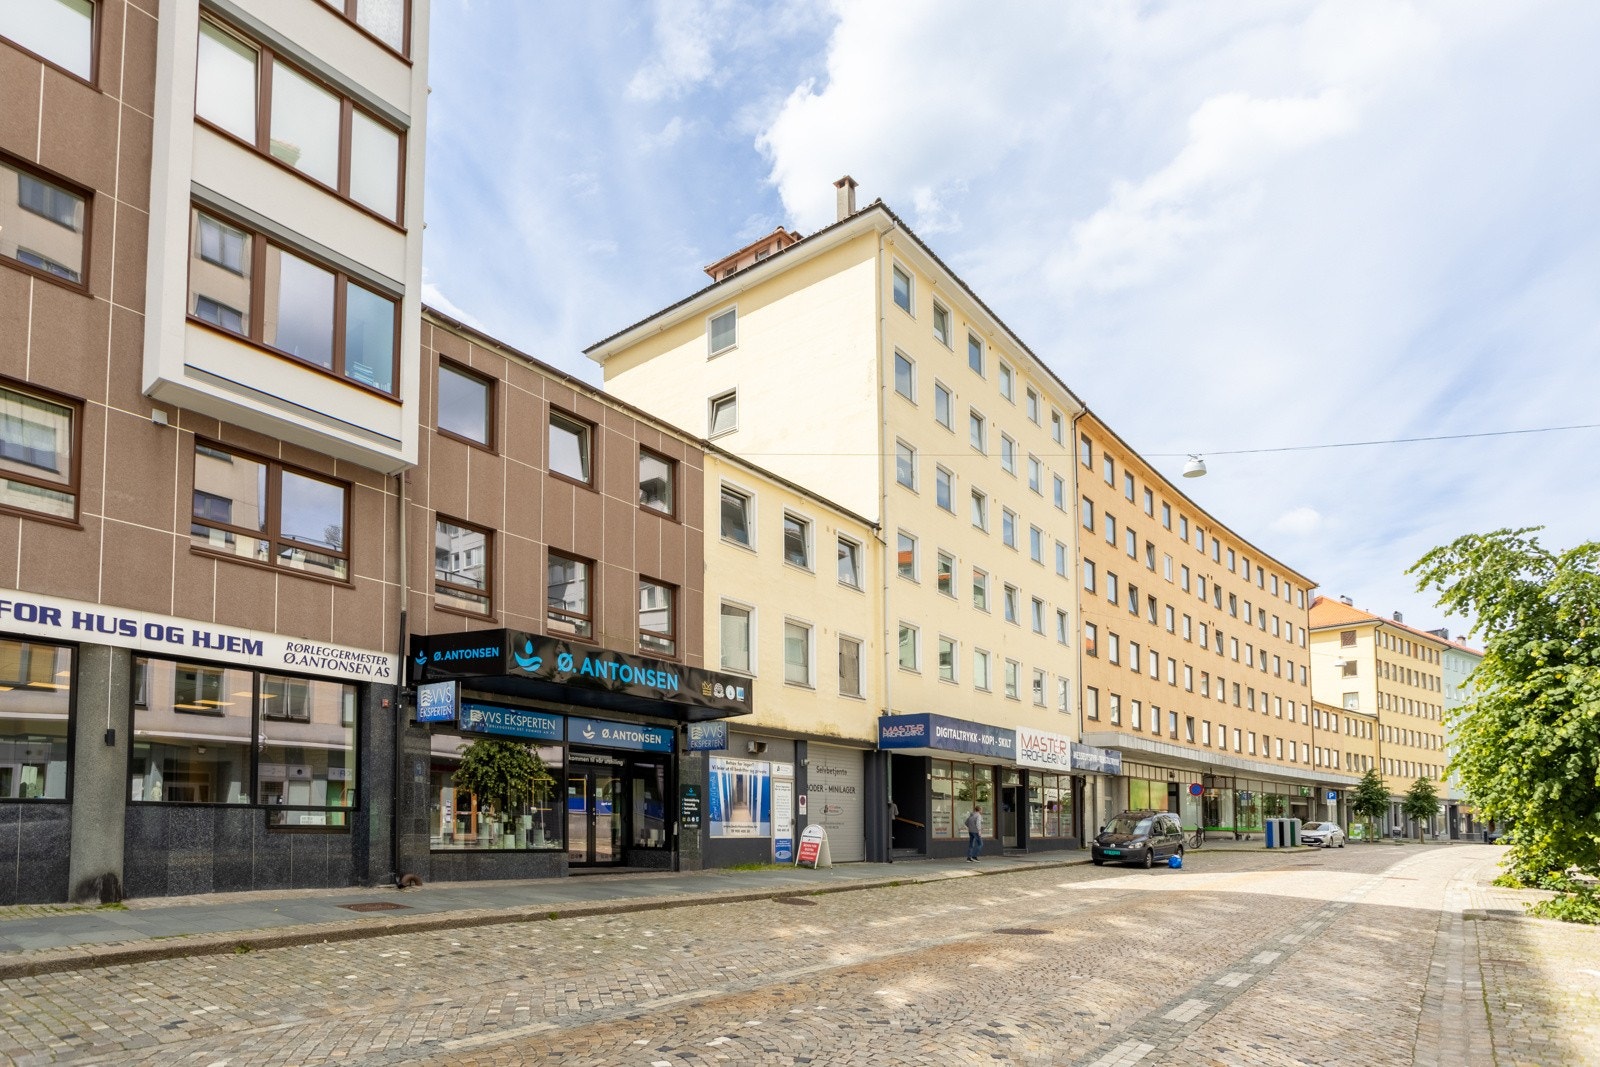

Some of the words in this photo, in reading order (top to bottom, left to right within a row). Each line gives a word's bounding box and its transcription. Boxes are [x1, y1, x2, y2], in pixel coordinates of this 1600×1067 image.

[72, 611, 137, 637] HUS
[144, 623, 184, 645] OG
[192, 630, 263, 656] HJEM
[286, 642, 388, 665] RØRLEGGERMESTER
[444, 647, 499, 660] ANTONSEN
[375, 666, 390, 678] AS
[580, 657, 679, 691] ANTONSEN
[433, 687, 452, 704] VVS
[420, 705, 452, 718] EKSPERTEN
[482, 711, 501, 724] VVS
[504, 713, 556, 730] EKSPERTEN
[613, 730, 662, 744] ANTONSEN
[703, 725, 723, 738] VVS
[936, 726, 978, 743] DIGITALTRYKK
[981, 734, 995, 746] KOPI
[998, 737, 1012, 749] SKILT
[690, 739, 723, 748] EKSPERTEN
[1021, 733, 1067, 755] MASTER
[828, 785, 856, 794] MINILAGER
